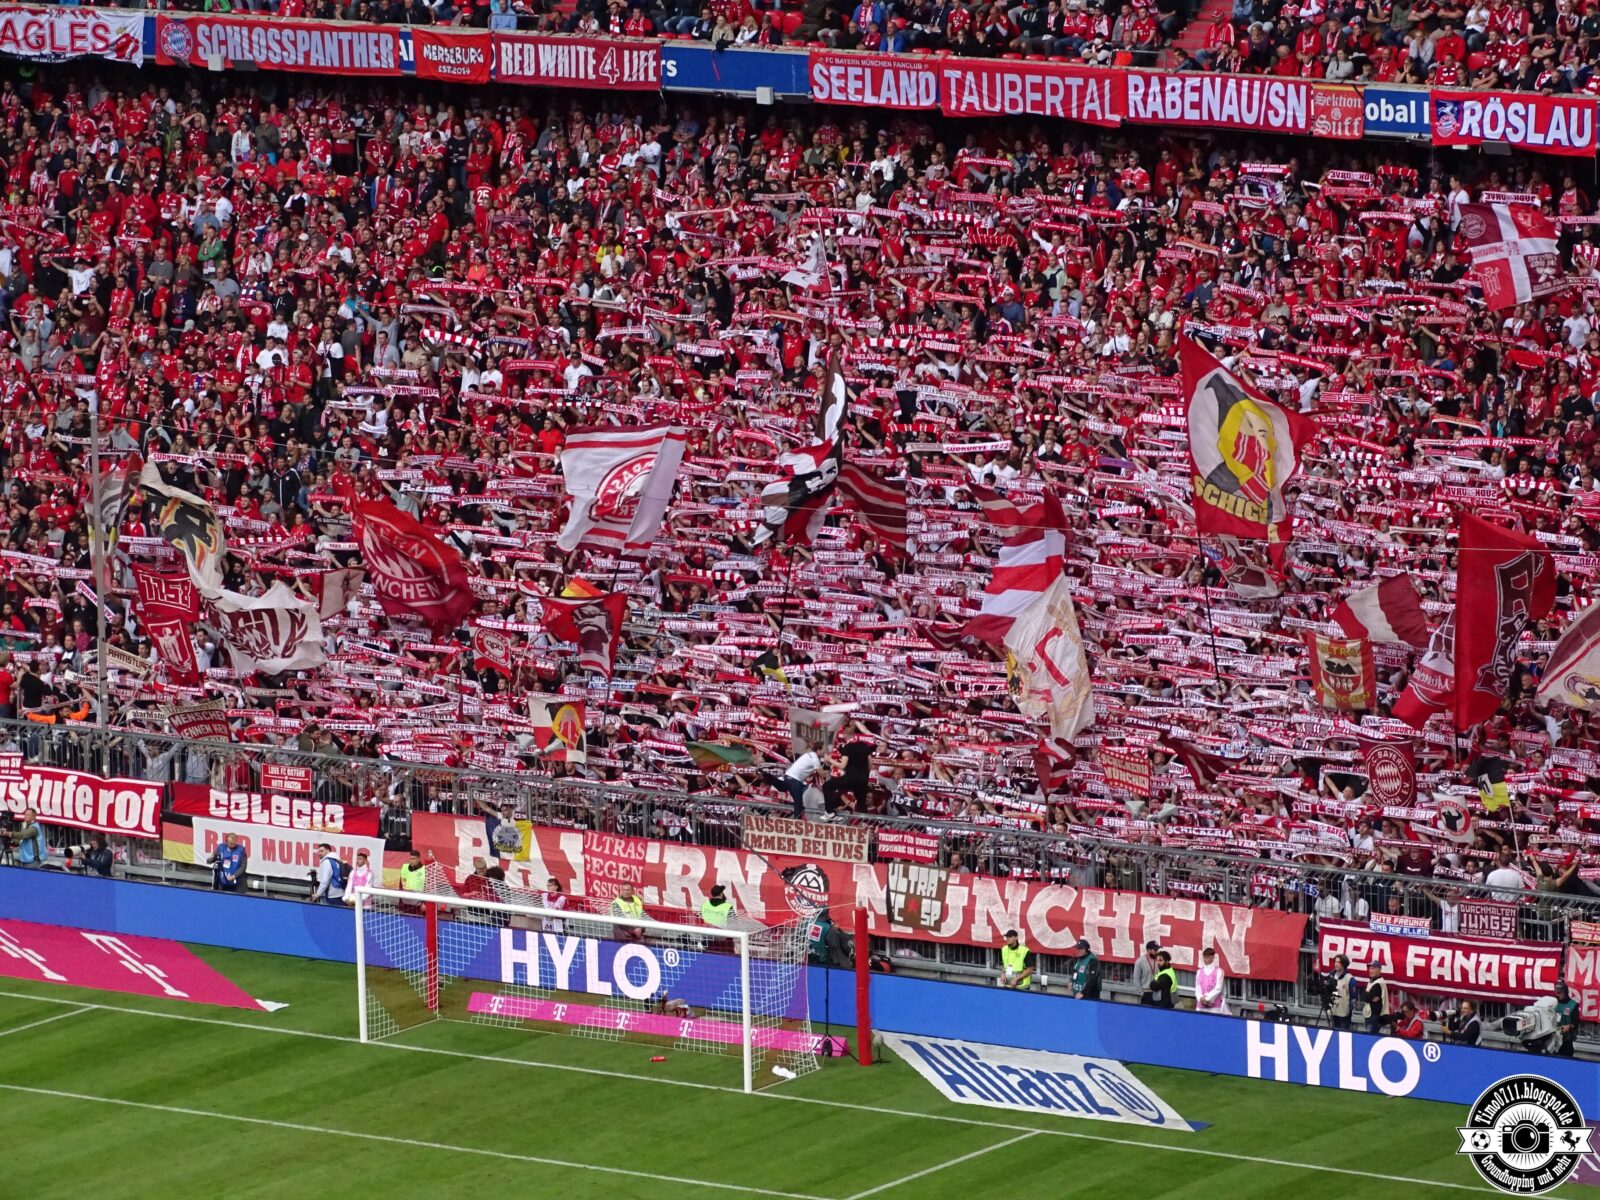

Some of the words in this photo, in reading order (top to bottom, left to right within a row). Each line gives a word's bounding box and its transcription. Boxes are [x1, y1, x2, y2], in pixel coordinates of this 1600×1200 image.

[197, 23, 394, 69] SCHLOSSPANTHER
[423, 44, 484, 64] MERSEBURG
[501, 42, 535, 76] RED
[539, 44, 596, 80] WHITE
[599, 46, 620, 84] 4
[623, 49, 657, 82] LIFE
[861, 59, 892, 67] MÜNCHEN
[893, 61, 922, 70] FANCLUB
[813, 62, 937, 107] SEELAND
[943, 69, 1121, 122] TAUBERTAL
[1127, 74, 1307, 129] RABENAU/SN
[1315, 92, 1362, 108] Sektion
[1313, 114, 1362, 136] Suff
[1458, 97, 1593, 148] RÖSLAU
[1377, 749, 1406, 772] BAYERN
[0, 773, 94, 823] stufe
[97, 787, 160, 833] rot
[745, 815, 867, 844] AUSGESPERRTE
[205, 829, 251, 861] RD
[584, 832, 645, 860] ULTRAS
[745, 833, 797, 853] IMMER
[801, 838, 828, 856] BEI
[832, 842, 864, 860] UNS
[455, 819, 768, 919] BAYRN
[584, 854, 643, 883] GEGEN
[853, 864, 1252, 974] MÜNCHEN
[1371, 914, 1393, 924] GUTE
[1460, 903, 1516, 917] DURCHHALTEN
[1461, 913, 1516, 932] JUNGS!
[1370, 922, 1387, 933] SIND
[900, 1039, 1124, 1117] Allianz
